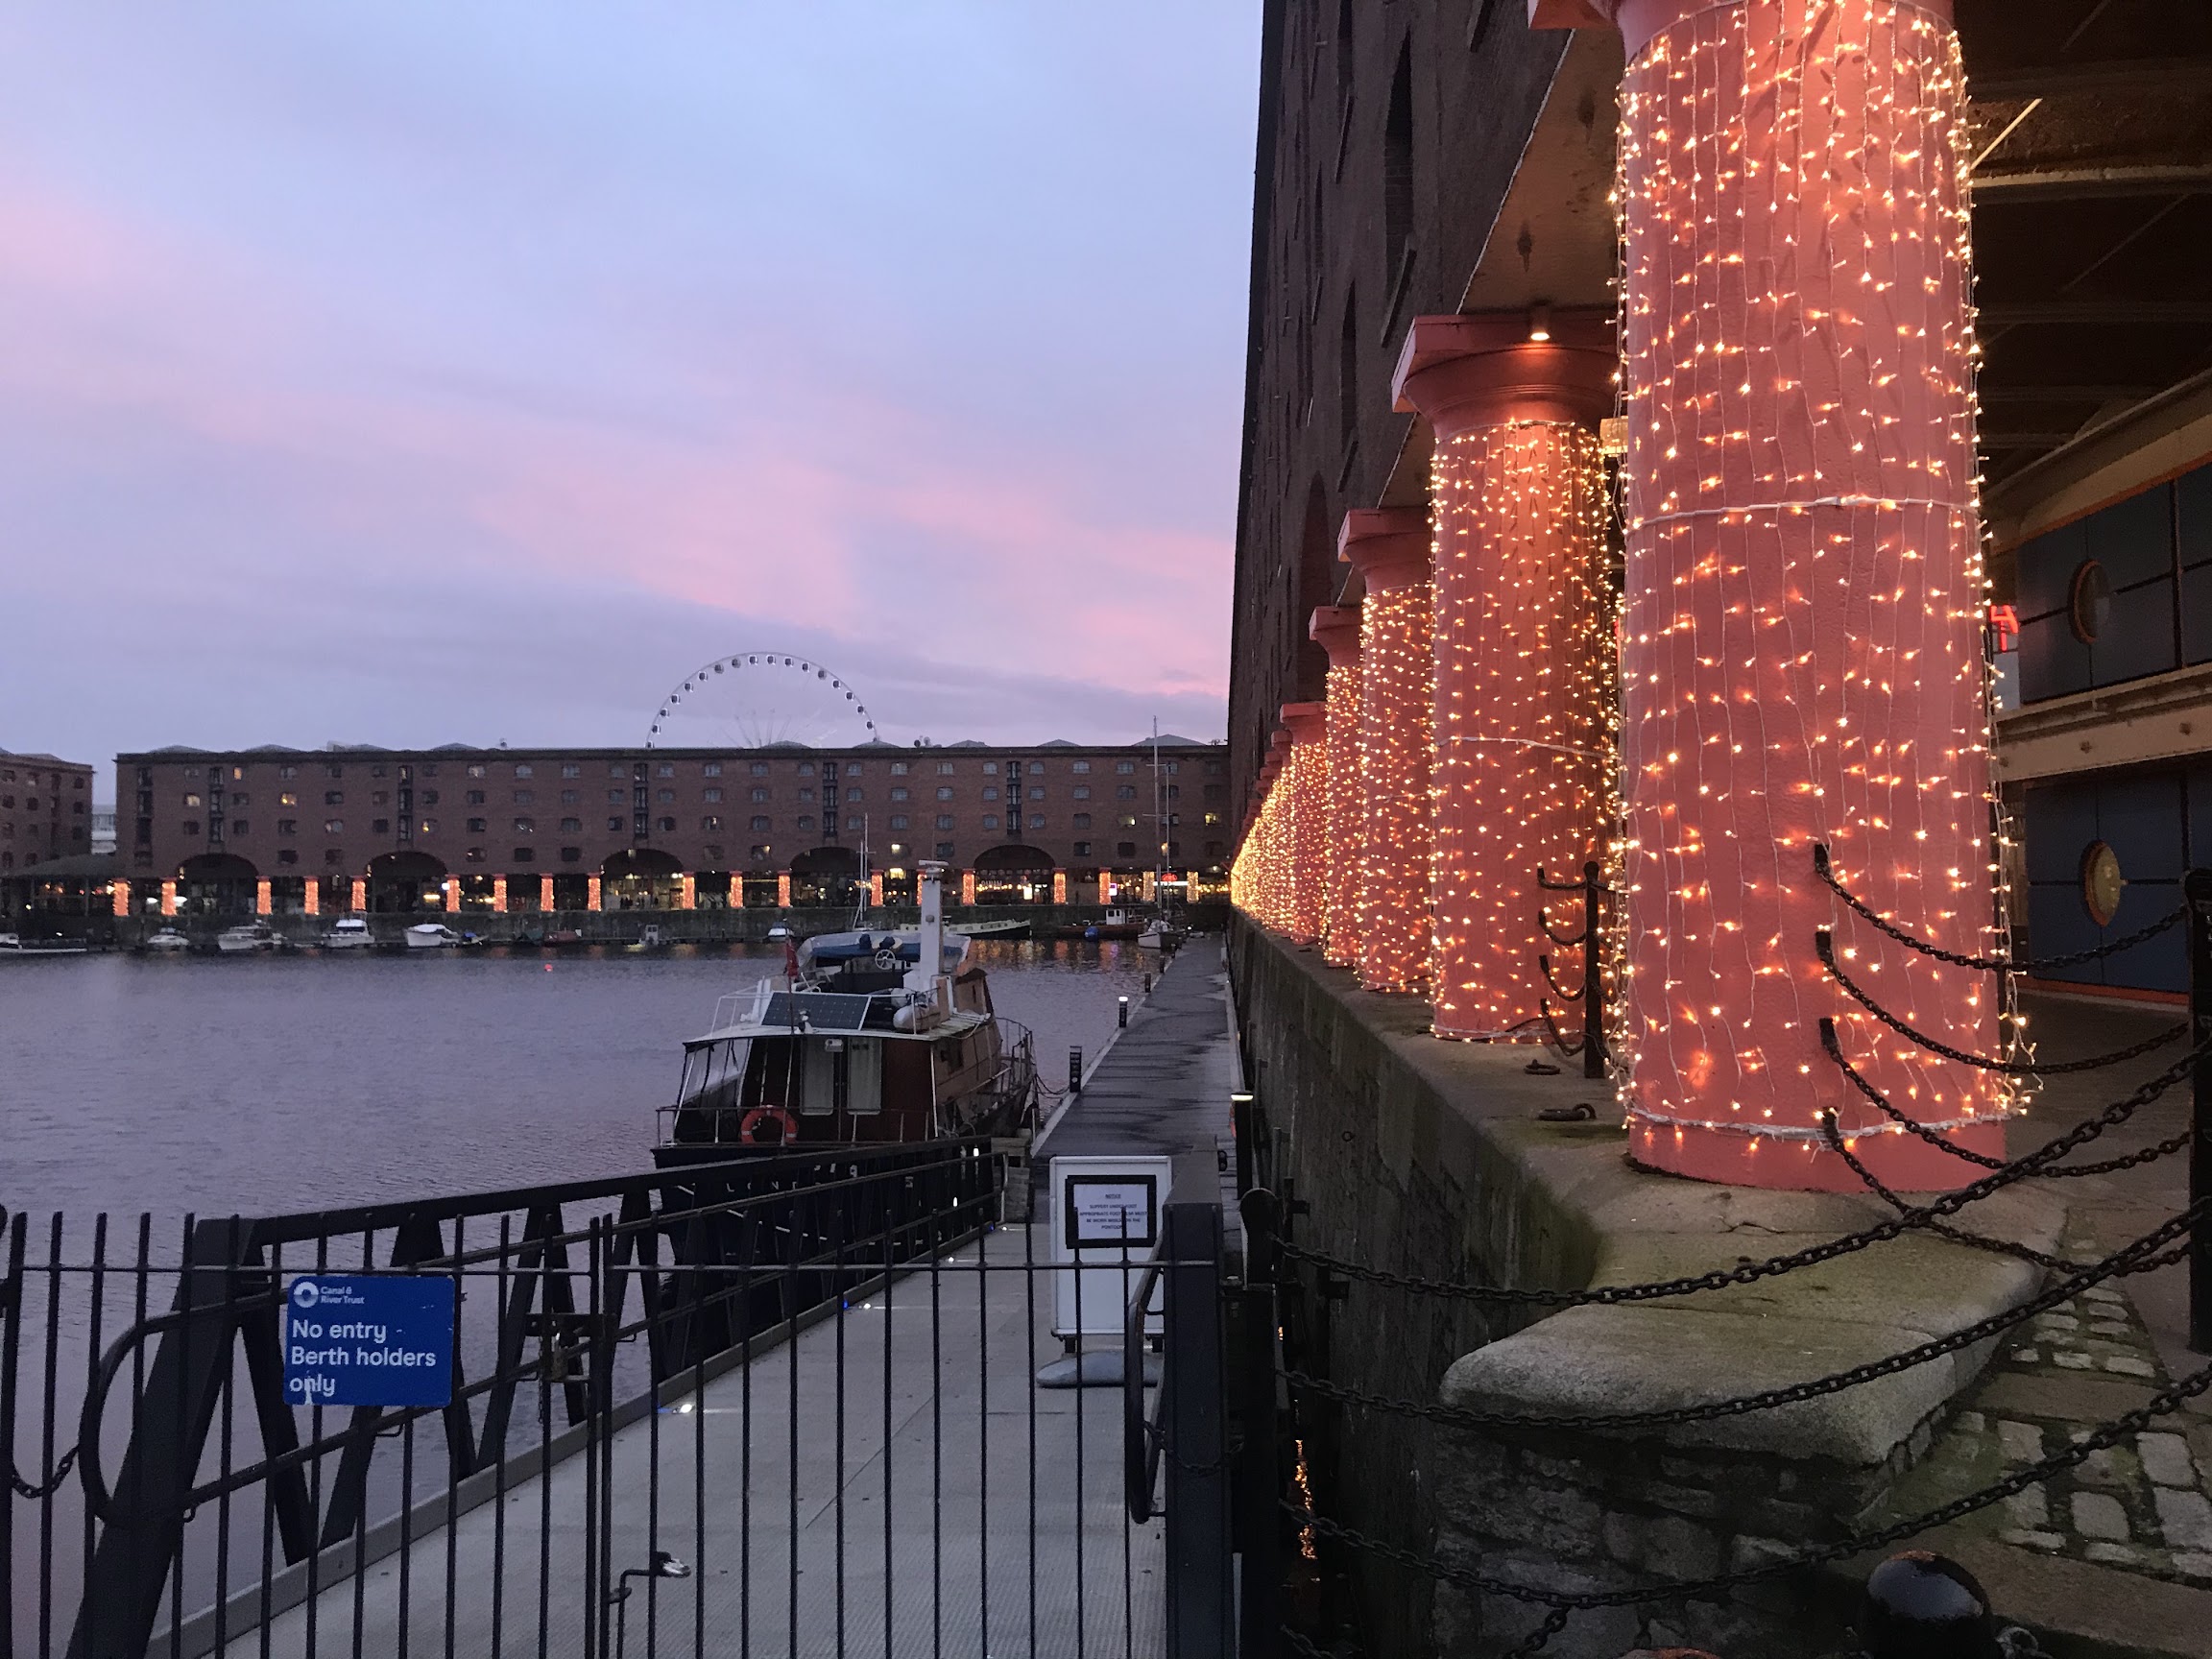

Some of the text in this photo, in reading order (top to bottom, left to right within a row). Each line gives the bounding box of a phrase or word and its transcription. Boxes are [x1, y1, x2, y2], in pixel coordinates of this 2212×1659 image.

[321, 1286, 352, 1295] Canal &
[321, 1295, 365, 1305] River Trust
[292, 1319, 387, 1344] No entry
[291, 1346, 437, 1367] Berth holders
[289, 1373, 336, 1397] only
